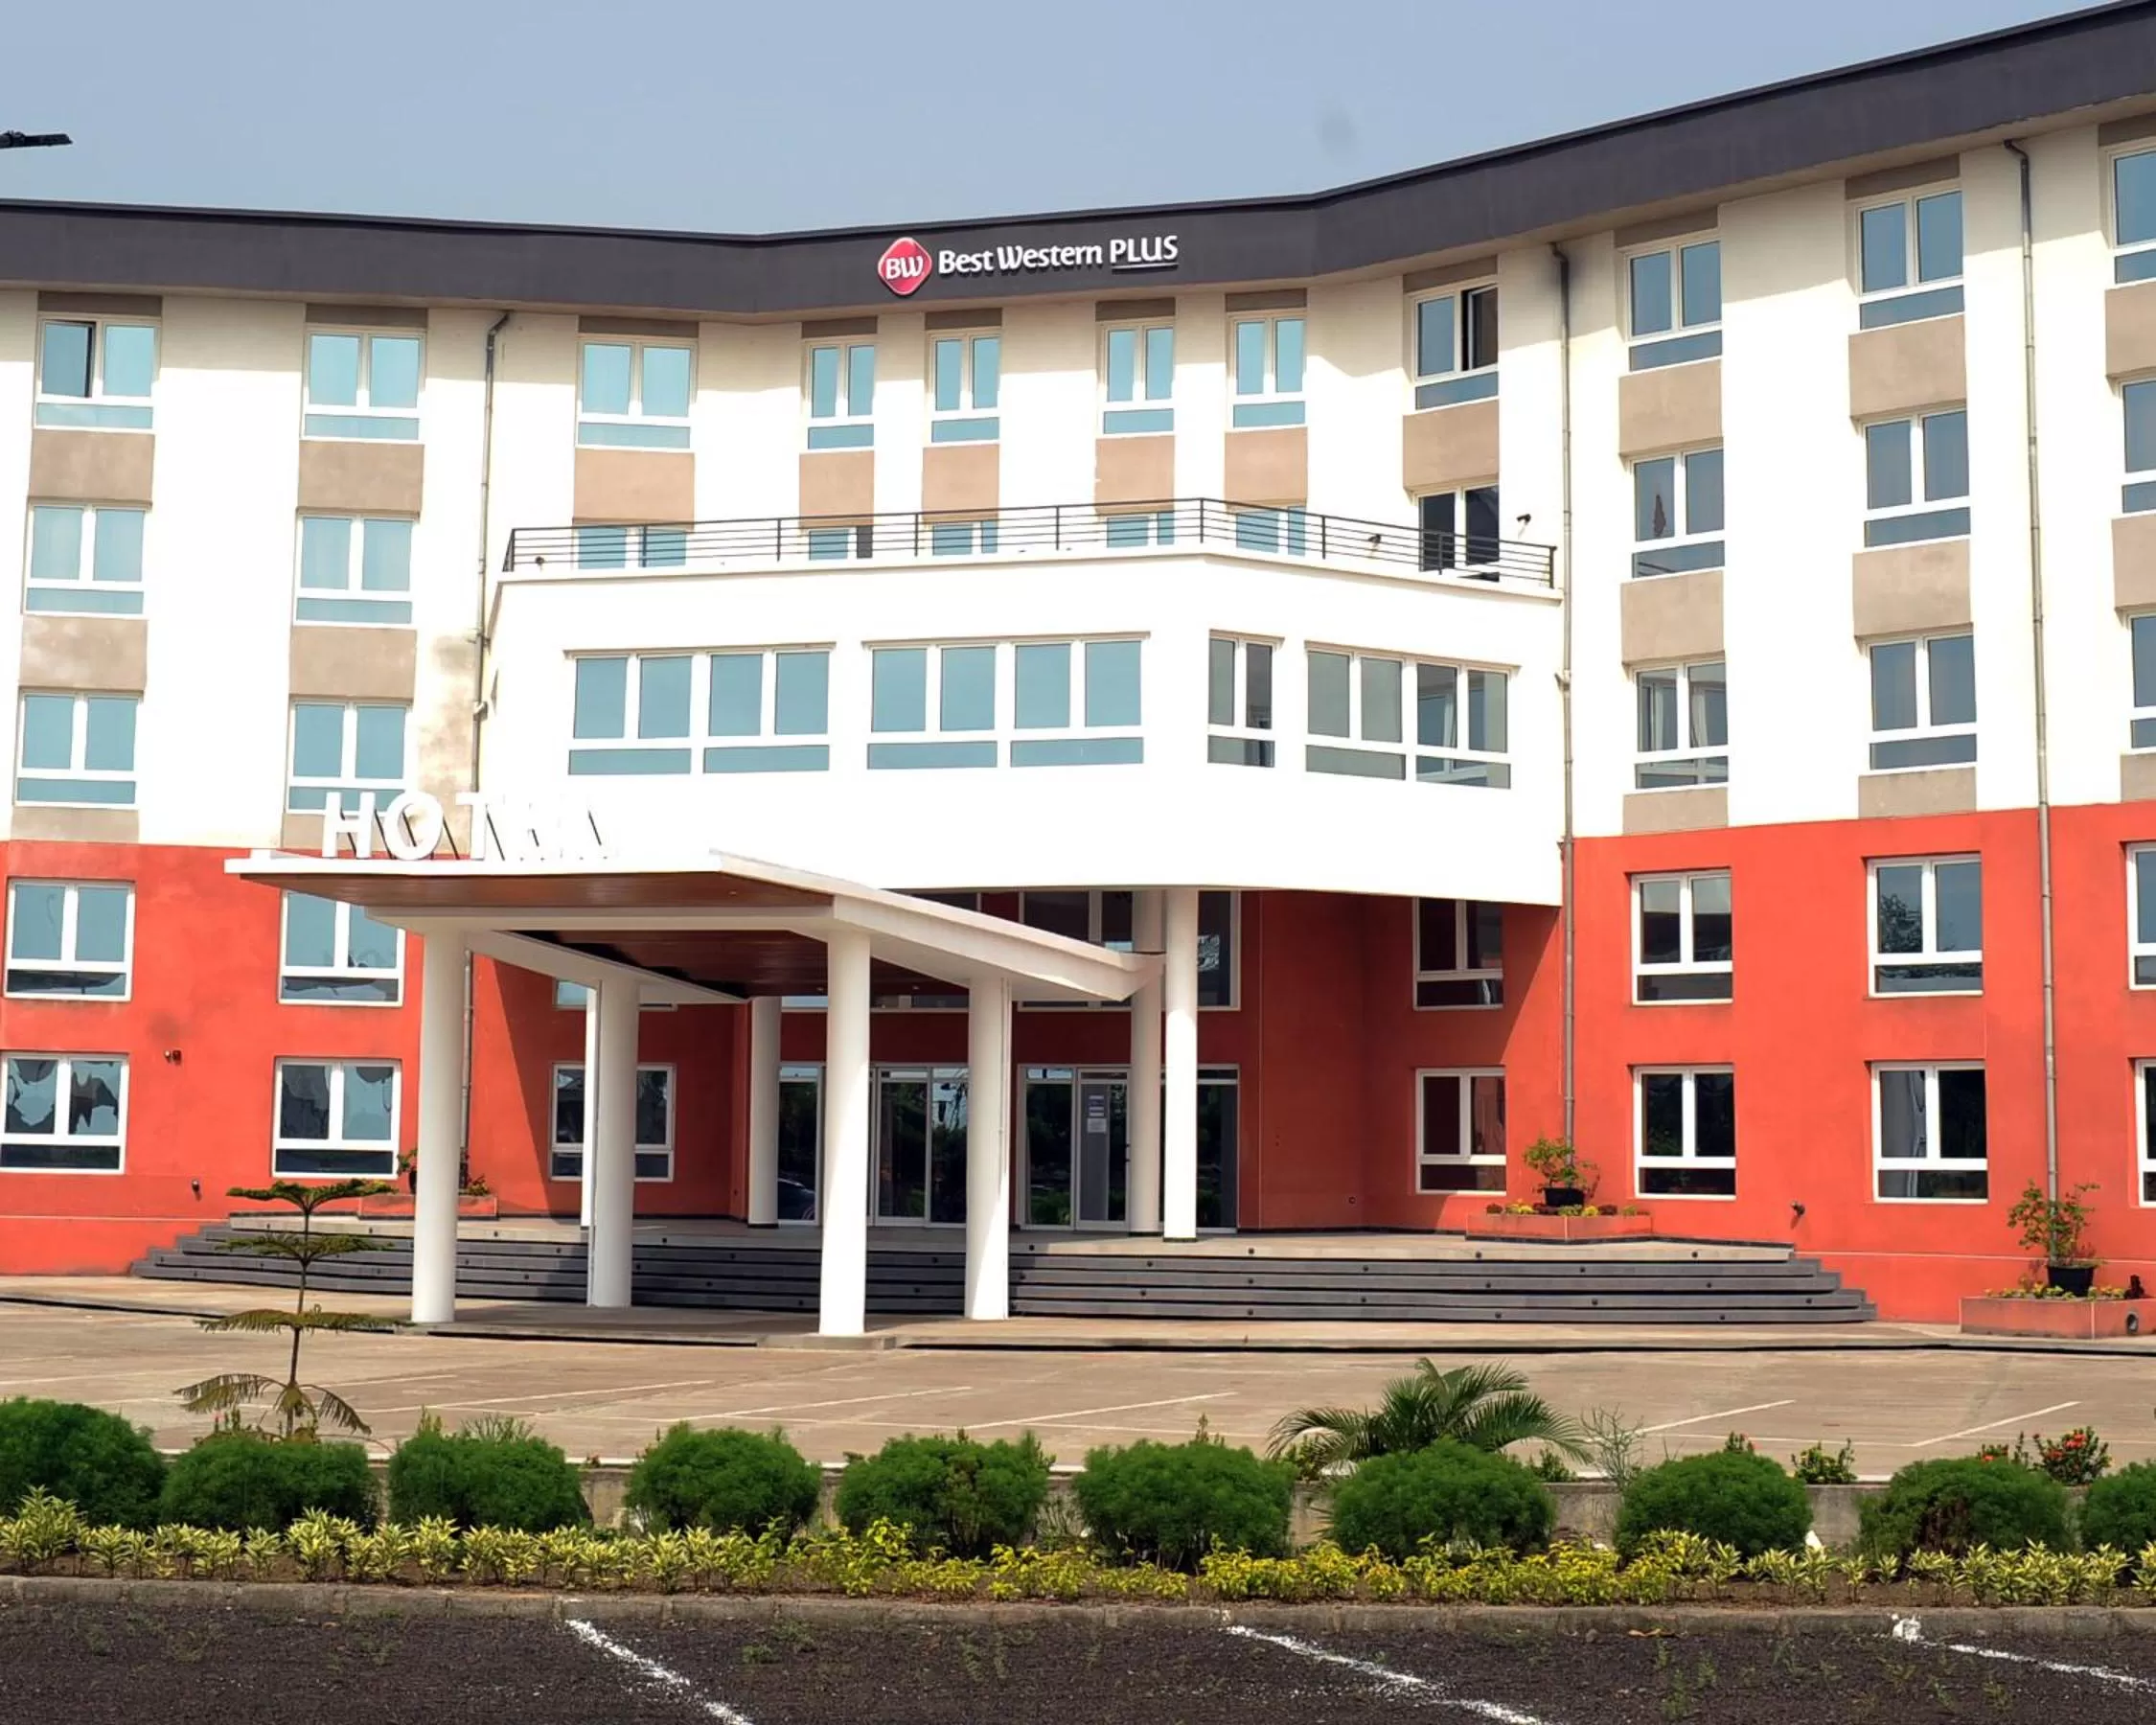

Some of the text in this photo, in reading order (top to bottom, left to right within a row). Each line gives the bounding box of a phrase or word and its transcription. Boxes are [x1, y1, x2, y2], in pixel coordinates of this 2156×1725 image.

[884, 255, 924, 280] BW
[938, 235, 1178, 275] Best Western PLUS
[321, 790, 618, 861] HOT
